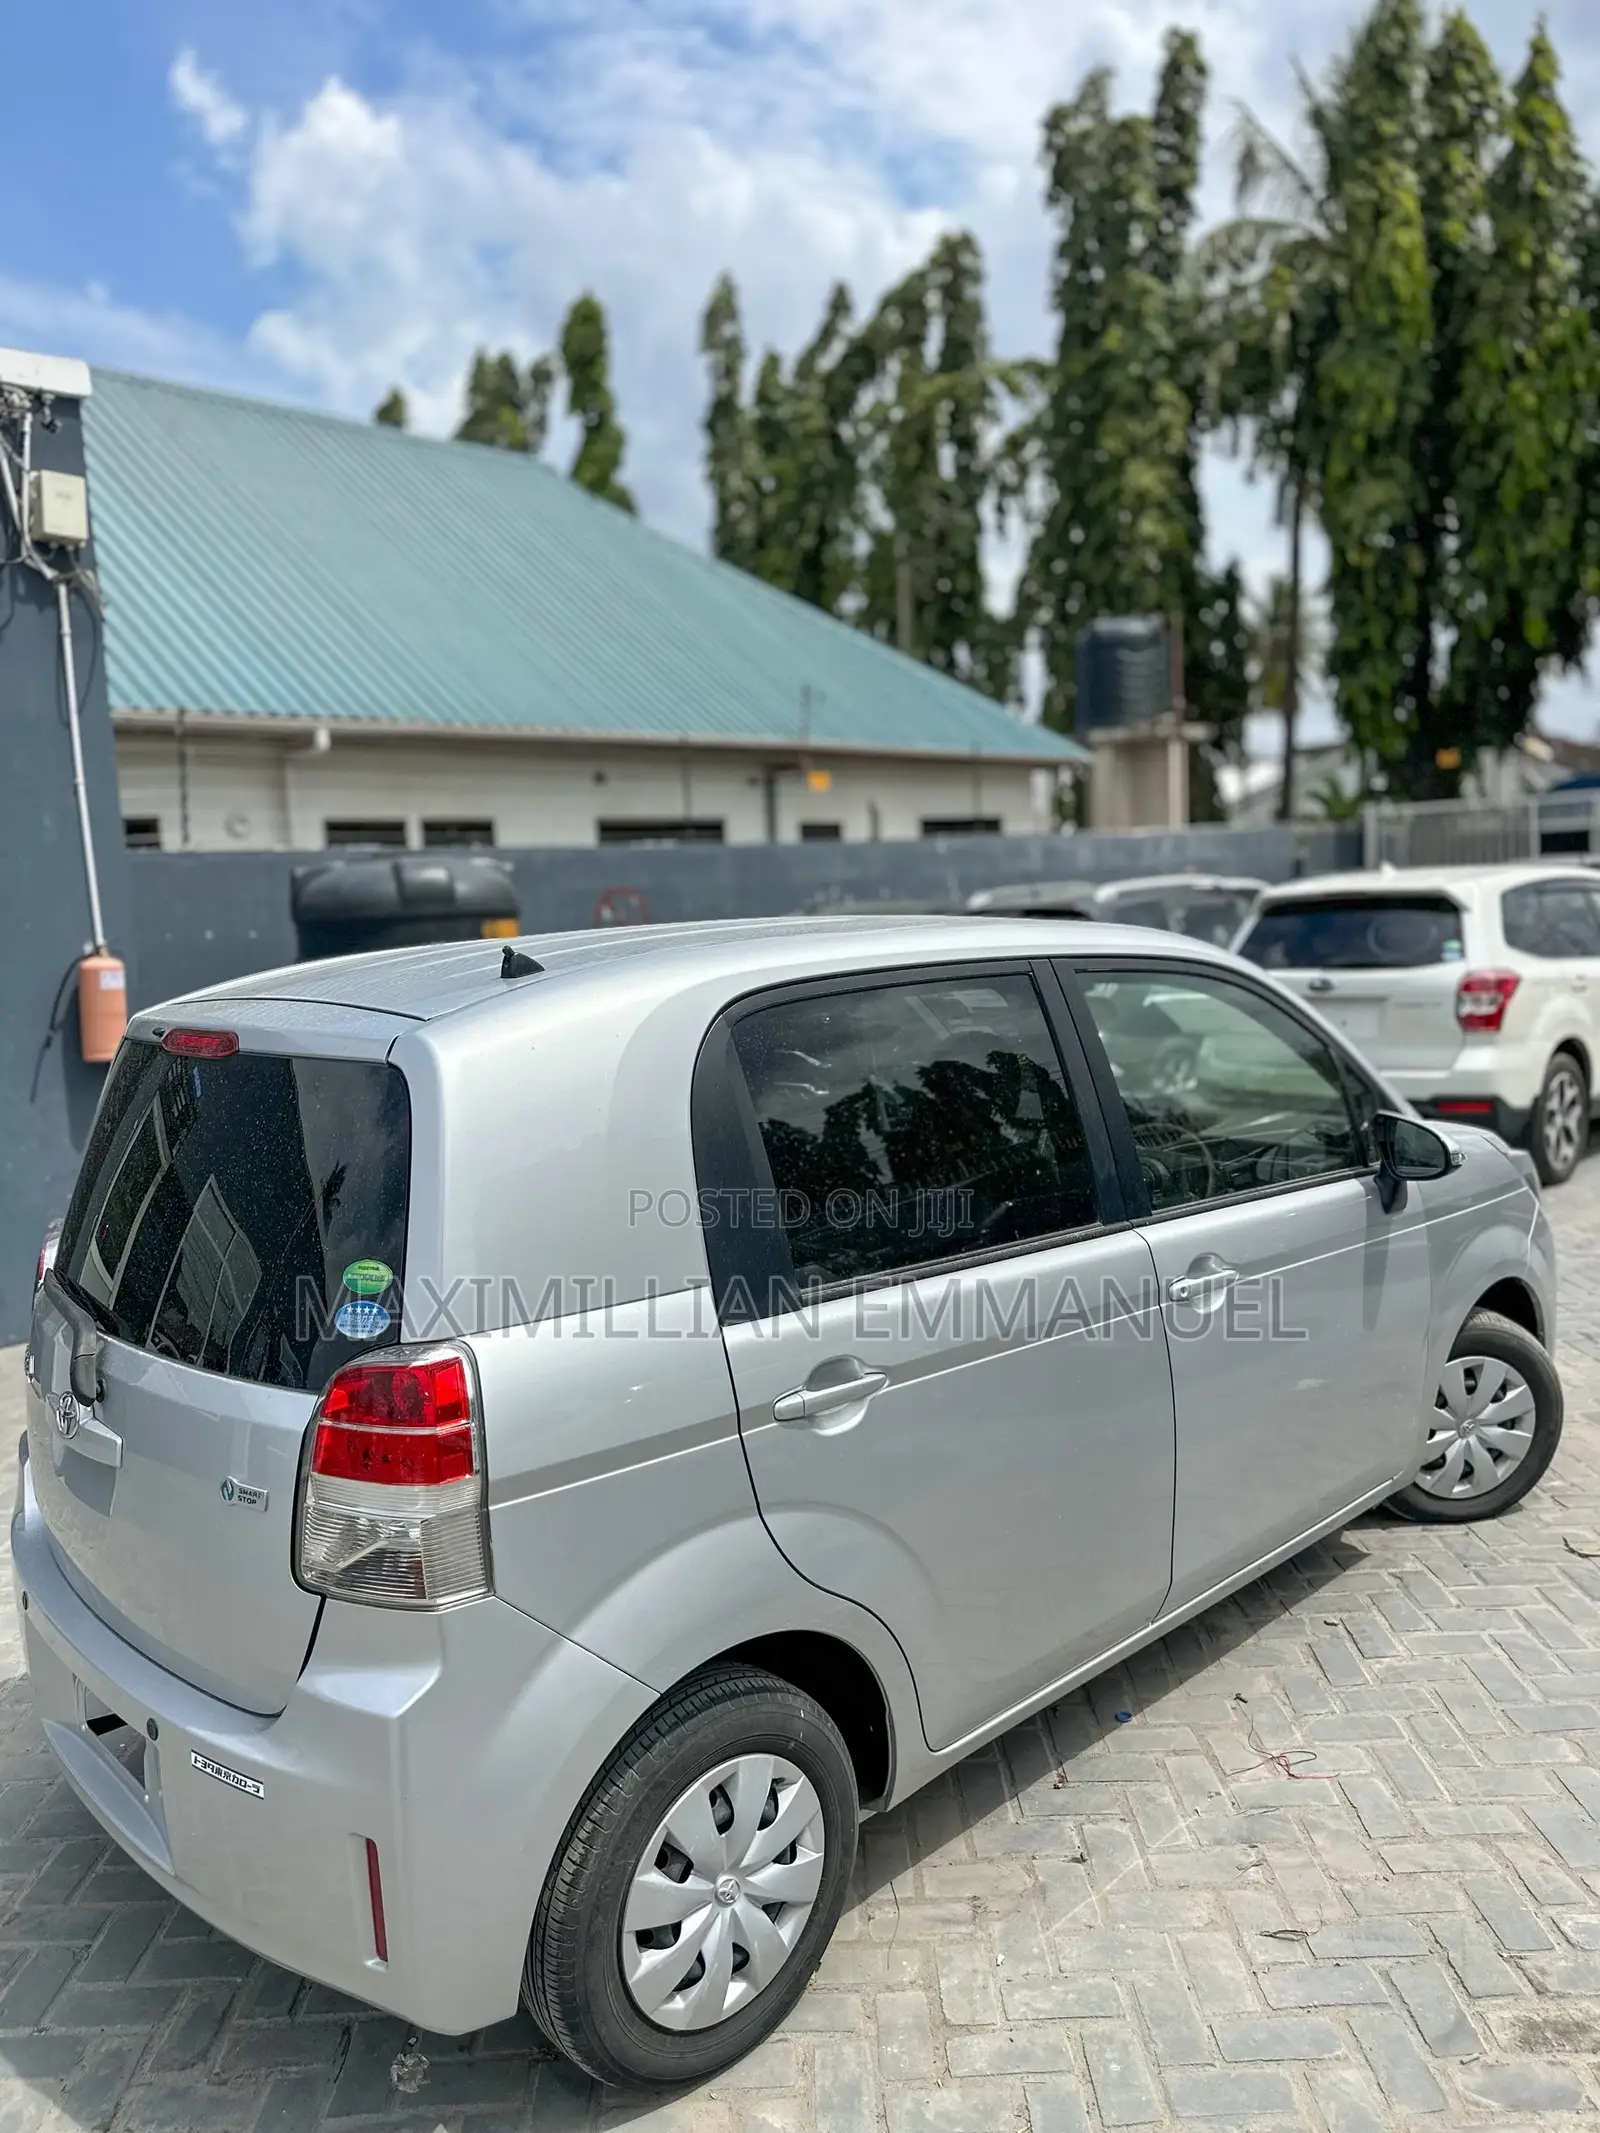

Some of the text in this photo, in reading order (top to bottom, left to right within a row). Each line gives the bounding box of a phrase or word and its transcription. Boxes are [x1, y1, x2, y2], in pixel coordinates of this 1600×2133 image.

[238, 1488, 262, 1499] SMART
[237, 1494, 257, 1505] STOP
[194, 1755, 261, 1794] トヨタ東京カローラ
